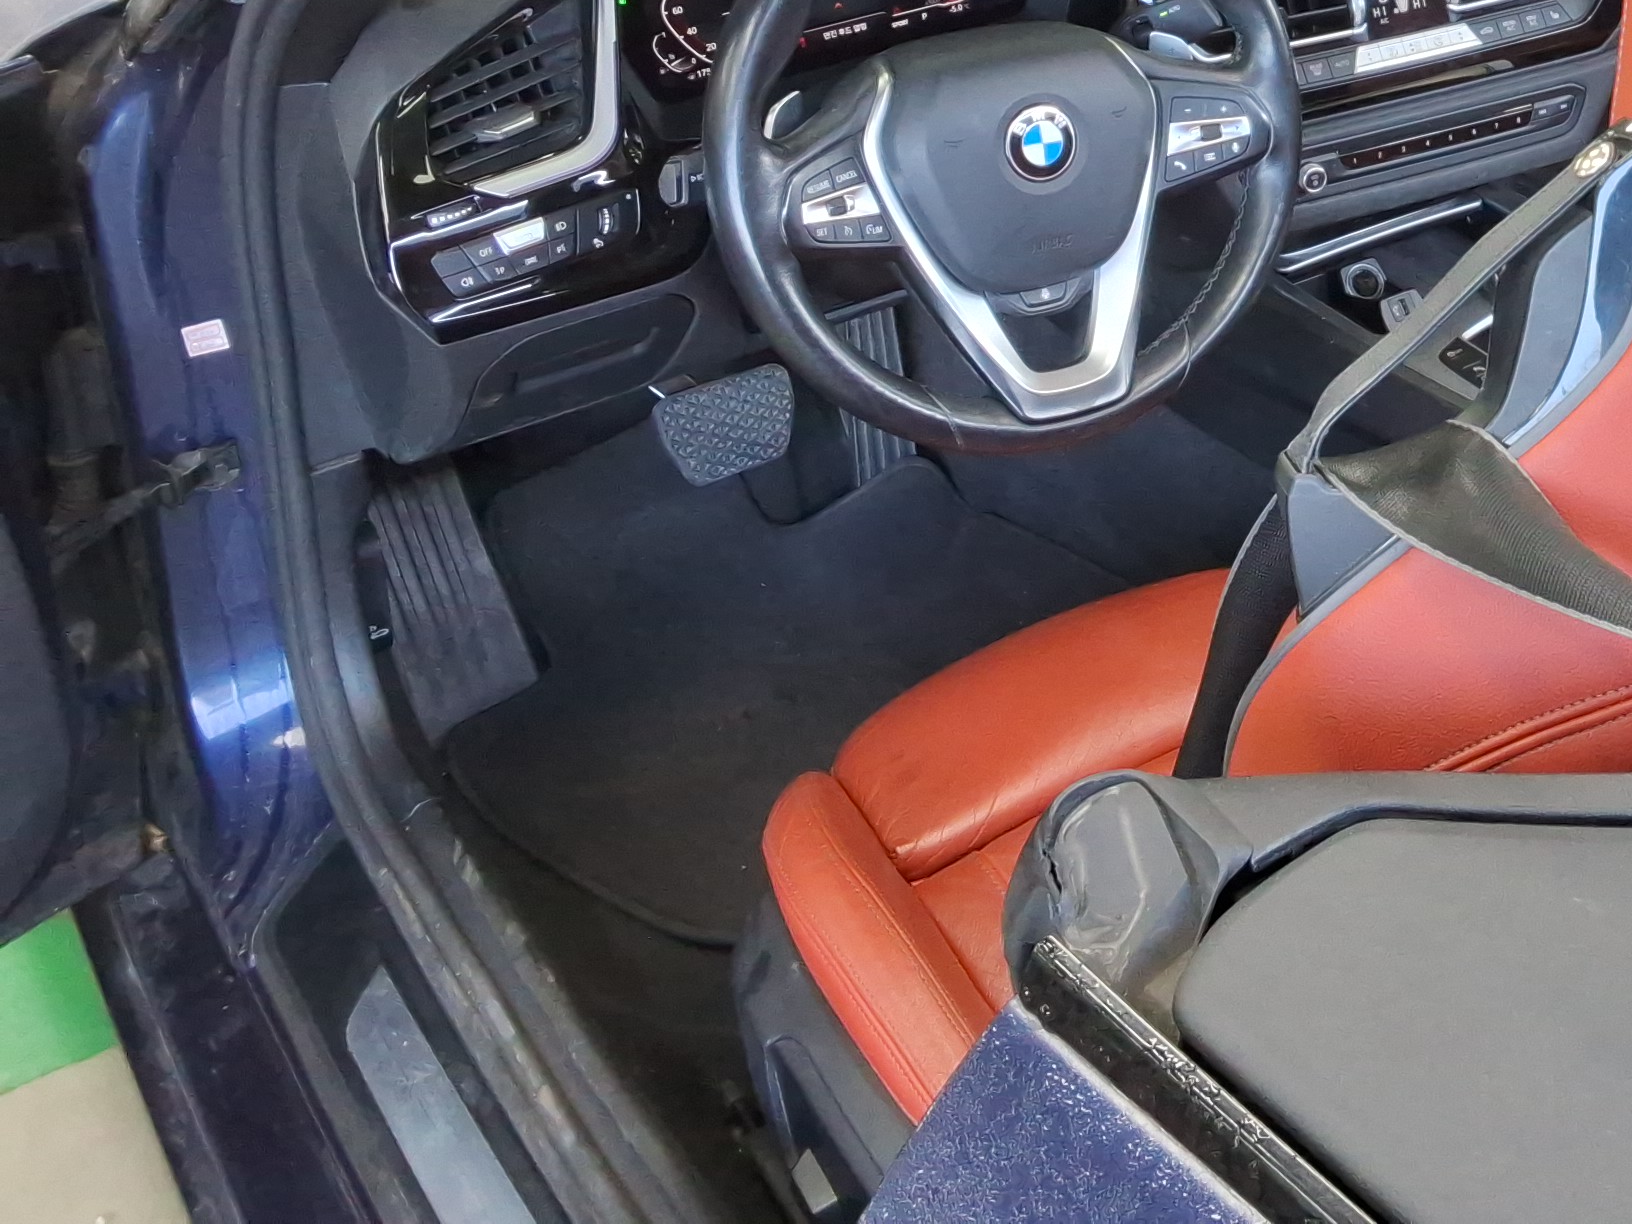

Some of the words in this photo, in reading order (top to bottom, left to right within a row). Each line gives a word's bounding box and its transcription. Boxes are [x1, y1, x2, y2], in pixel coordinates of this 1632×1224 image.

[672, 5, 684, 15] 60
[686, 26, 698, 36] 40
[705, 42, 717, 52] 20
[479, 246, 493, 257] OFF
